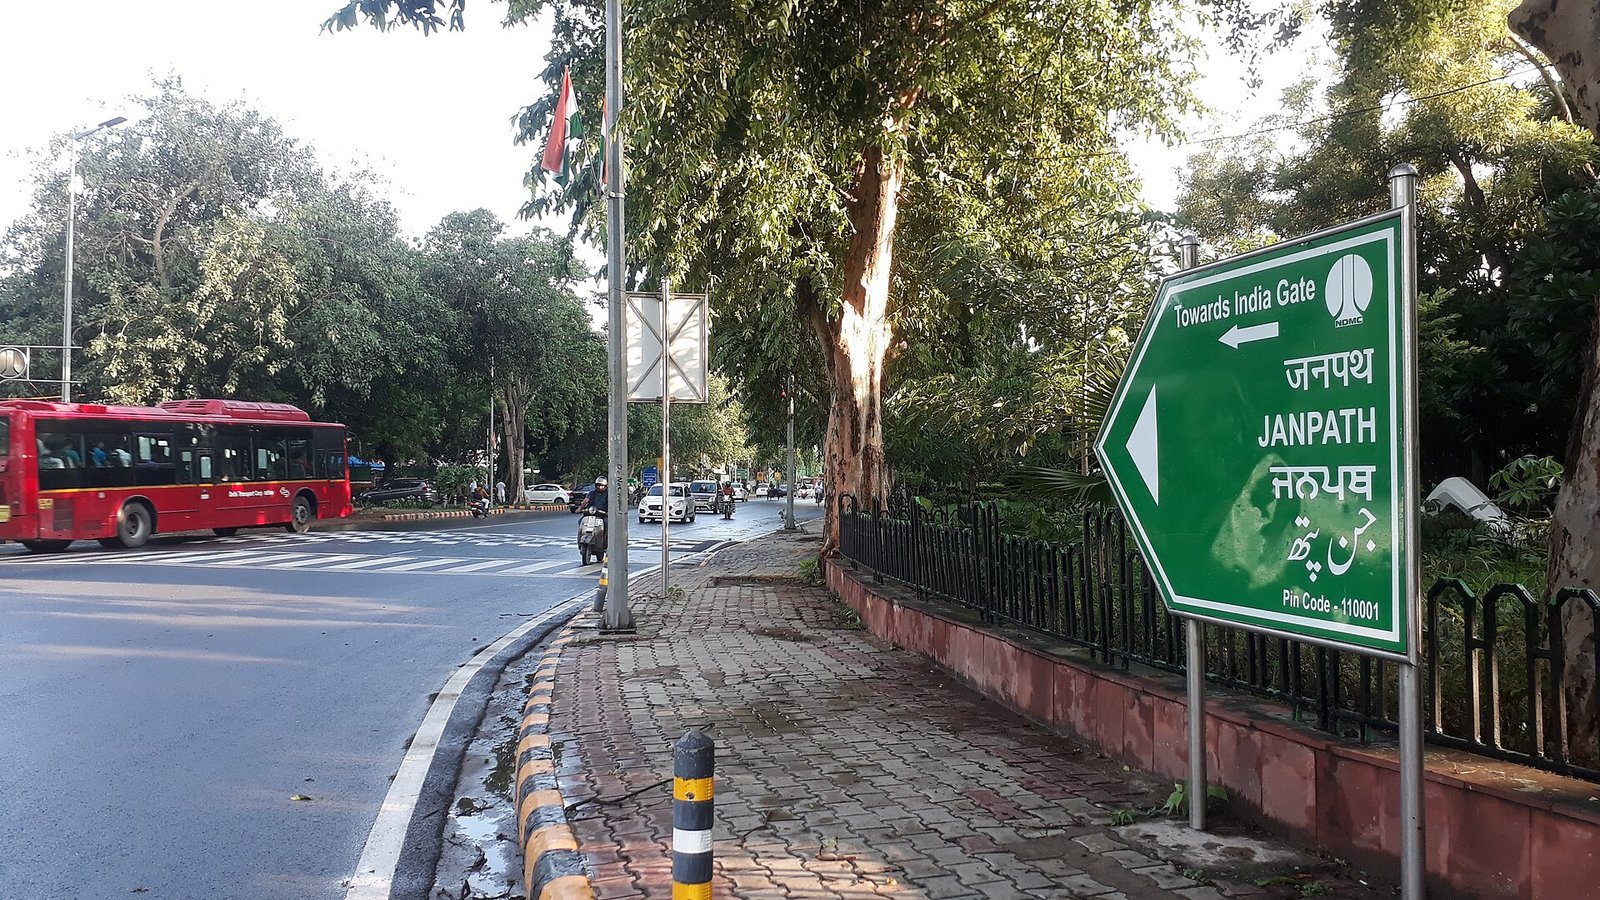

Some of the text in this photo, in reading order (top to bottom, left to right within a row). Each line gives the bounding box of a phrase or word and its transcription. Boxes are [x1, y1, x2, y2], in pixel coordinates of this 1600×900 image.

[1174, 275, 1316, 328] Towards India Gate
[1335, 316, 1363, 328] NDMC
[1283, 347, 1375, 391] जनपथ
[1257, 406, 1376, 448] JANPATH
[1269, 465, 1376, 501] ਜਨਪਥ
[1327, 507, 1377, 576] جن
[1283, 589, 1300, 608] Pin
[1302, 592, 1331, 613] Code
[1341, 597, 1379, 621] 110001
